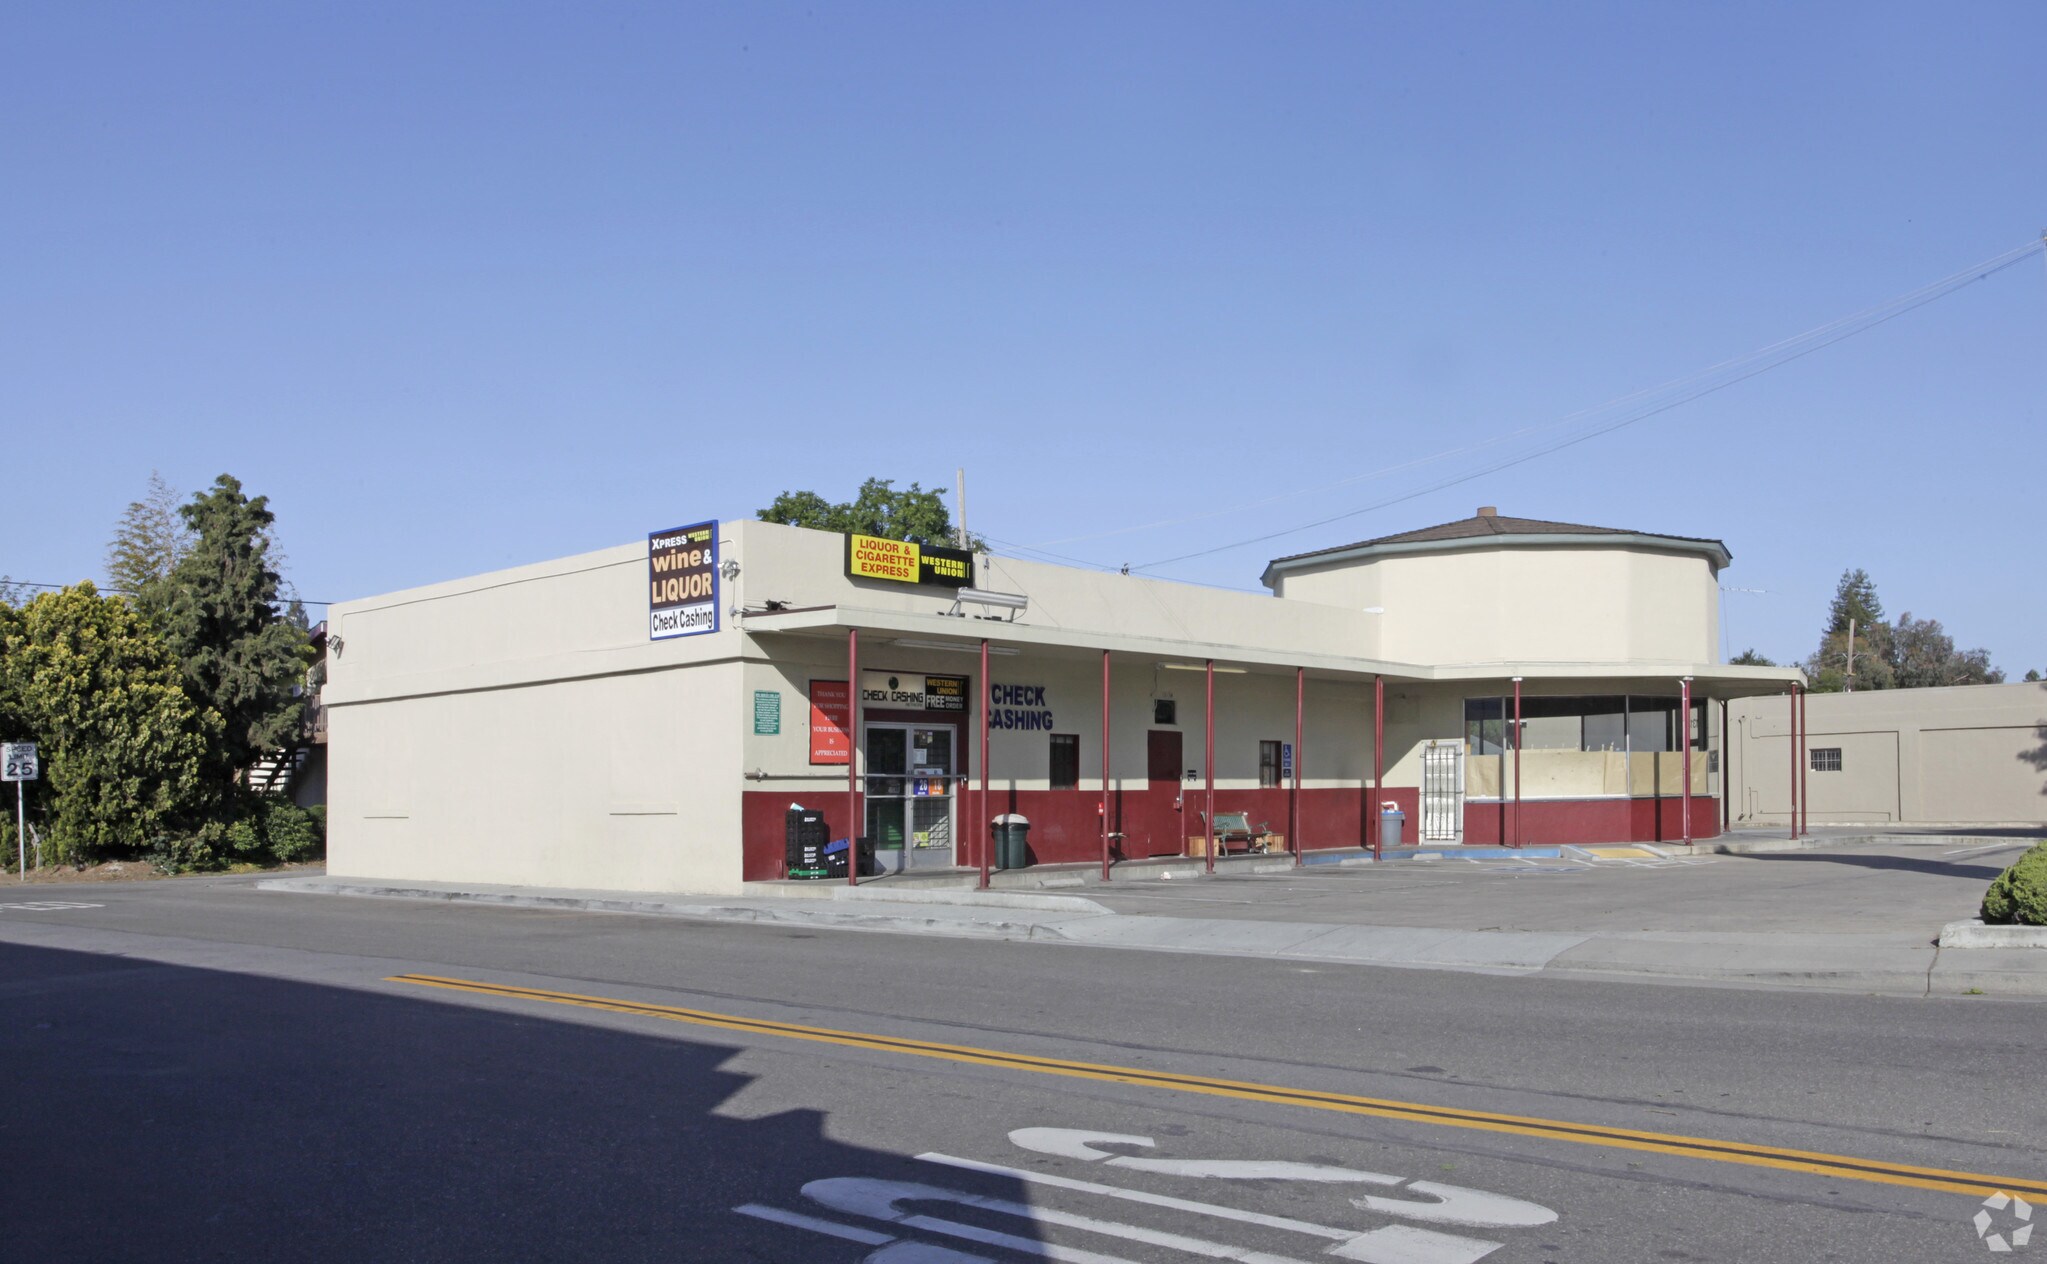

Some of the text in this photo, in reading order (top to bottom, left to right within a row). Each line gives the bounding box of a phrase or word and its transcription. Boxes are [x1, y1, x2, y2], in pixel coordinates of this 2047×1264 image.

[651, 535, 688, 550] XPRESS
[860, 539, 911, 556] LIQUOR &
[652, 548, 713, 573] wine &
[856, 550, 915, 567] CIGARETTE
[921, 555, 964, 570] WESTERN
[861, 562, 909, 578] EXPRESS
[934, 567, 964, 578] UNION
[652, 572, 713, 604] LIQUOR
[653, 607, 713, 632] Check Cashing
[926, 678, 958, 687] WESTERN
[862, 689, 924, 703] CHECK CASHING
[936, 687, 958, 695] UNION
[991, 684, 1046, 707] CHECK
[926, 694, 945, 708] FREE
[6, 745, 33, 753] SPEED
[7, 762, 33, 776] 25
